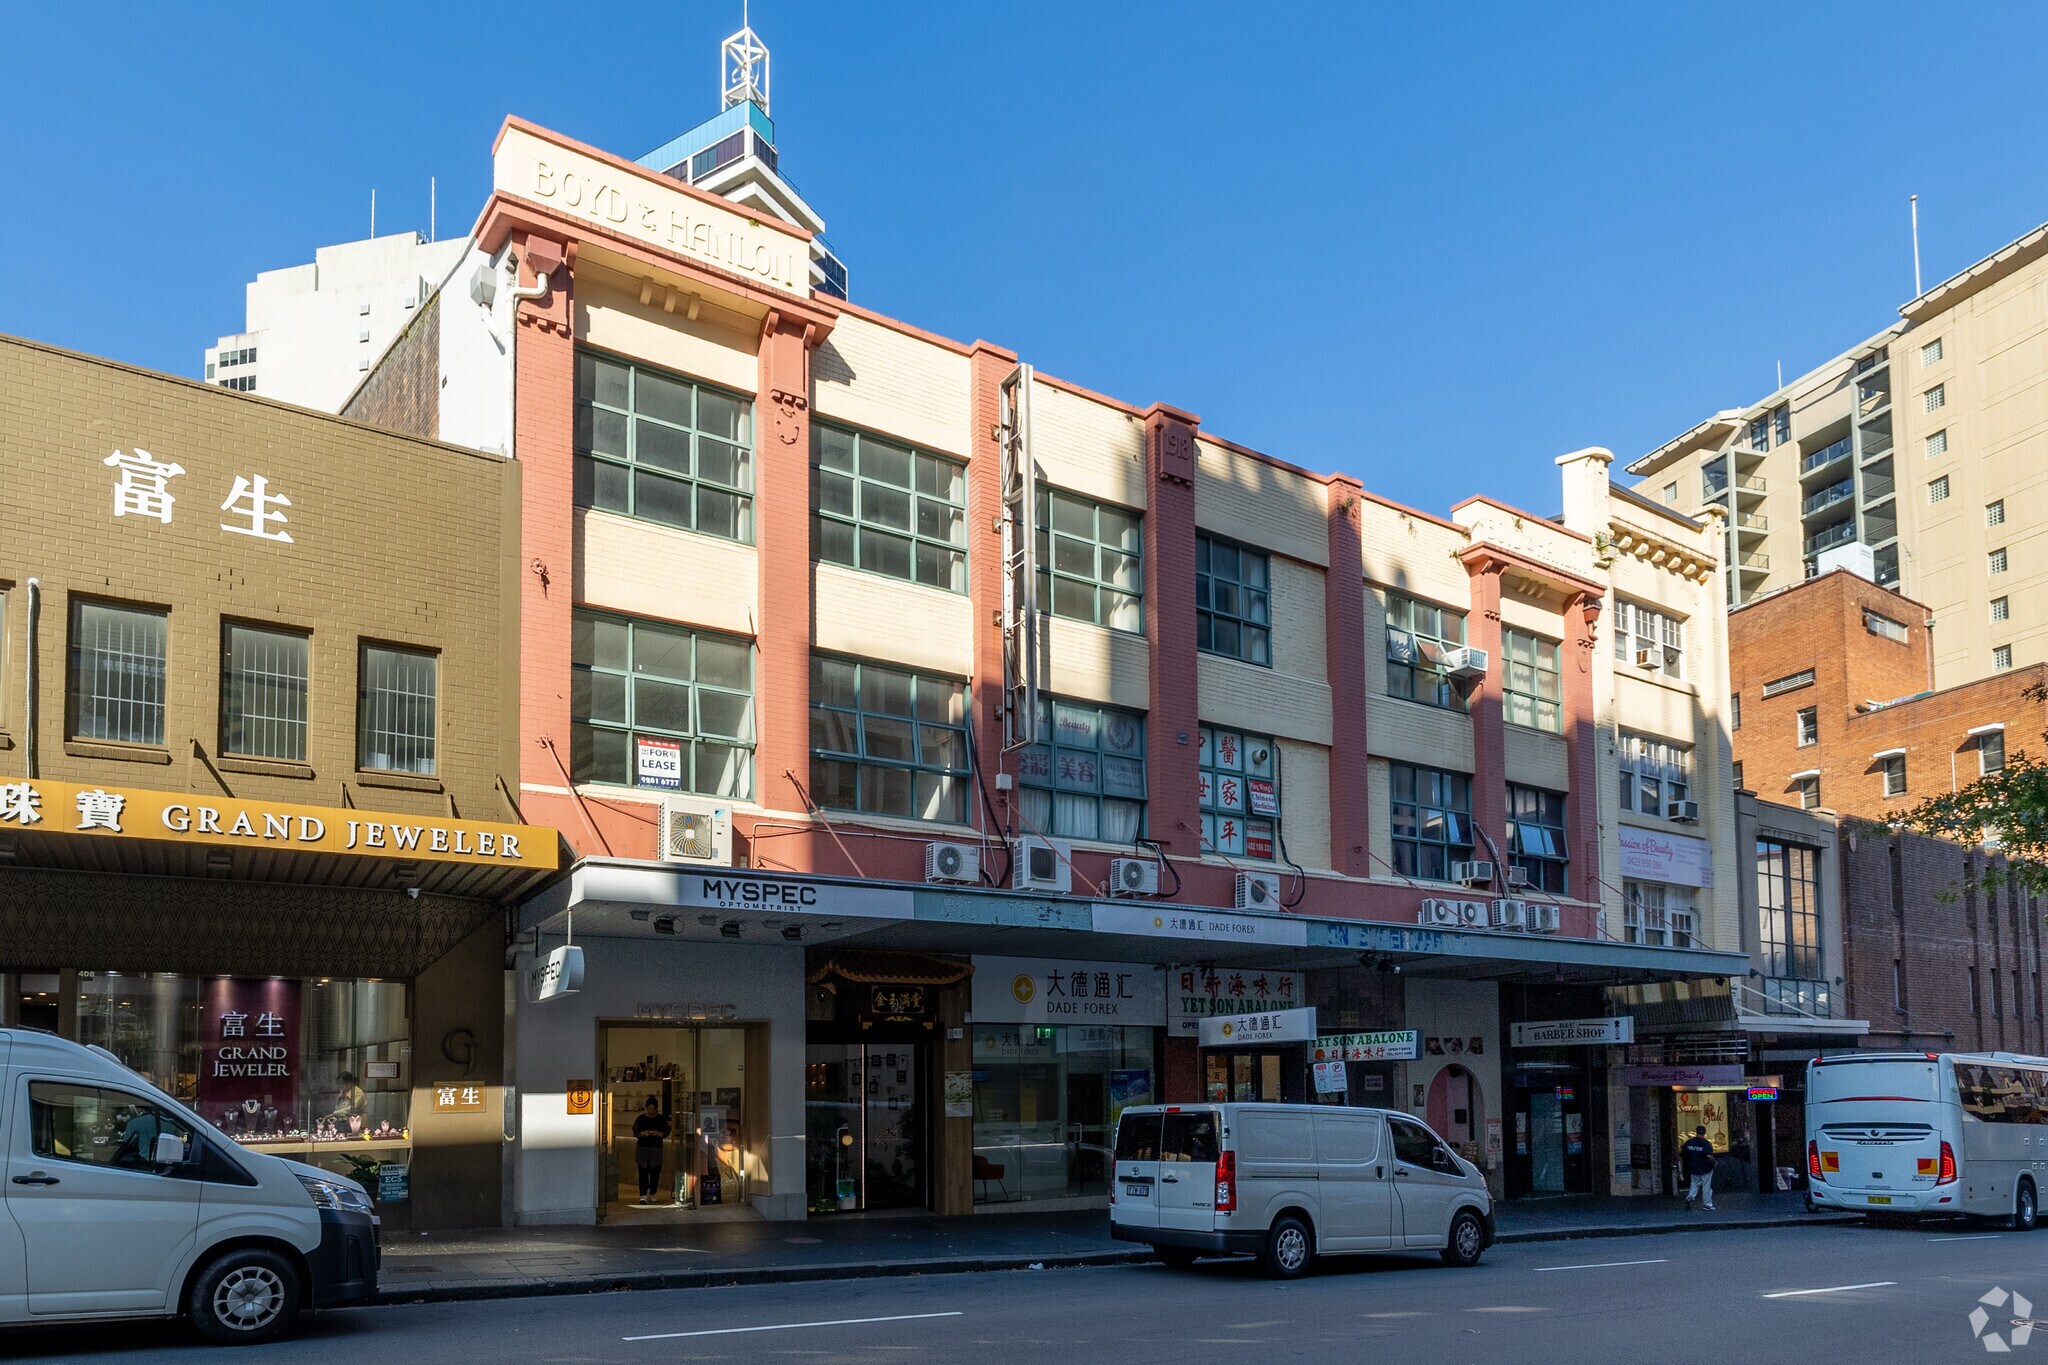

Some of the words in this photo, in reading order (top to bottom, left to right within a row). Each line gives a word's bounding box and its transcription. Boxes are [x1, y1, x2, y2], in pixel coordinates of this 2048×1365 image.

[533, 157, 628, 223] BOYD
[666, 208, 793, 287] HANLON
[103, 448, 294, 543] 富生
[1060, 716, 1091, 735] Beauty
[650, 749, 669, 757] FOR
[642, 759, 676, 770] LEASE
[1252, 793, 1275, 802] Chinese
[1253, 801, 1276, 810] Medicine
[0, 783, 126, 832] 珠寶
[161, 804, 326, 842] GRAND
[345, 820, 522, 858] JEWELER
[1642, 838, 1649, 857] of
[1650, 839, 1673, 861] Beauty
[1626, 856, 1641, 867] 0423
[703, 879, 817, 905] MYSPEC
[719, 901, 802, 911] OPTOMETRIST
[1170, 917, 1204, 930] 大德通汇
[1209, 922, 1230, 932] DADE
[1232, 924, 1255, 934] FOREX
[532, 961, 561, 988] MYSPEC
[1047, 969, 1133, 998] 大德通汇
[1180, 971, 1294, 998] 日新海味行
[1047, 1002, 1077, 1014] DADE
[1084, 1003, 1118, 1015] FOREX
[1181, 997, 1206, 1013] YET
[1209, 998, 1234, 1014] SON
[221, 1010, 285, 1037] 富生
[1237, 1015, 1282, 1032] 大德通汇
[1238, 1033, 1253, 1041] DADE
[1254, 1032, 1273, 1040] FOREX
[1311, 1037, 1331, 1048] YET
[1333, 1035, 1355, 1047] SON
[1357, 1031, 1413, 1045] ABALONE
[1534, 1029, 1574, 1040] BARBER
[1579, 1028, 1605, 1039] SHOP
[219, 1047, 287, 1060] GRAND
[1331, 1047, 1385, 1060] 日新海味行
[1641, 1070, 1670, 1080] Passion
[1677, 1070, 1704, 1081] Beauty
[437, 1087, 480, 1106] 富生
[1677, 1104, 1698, 1115] Sale
[1703, 1104, 1725, 1125] Sale
